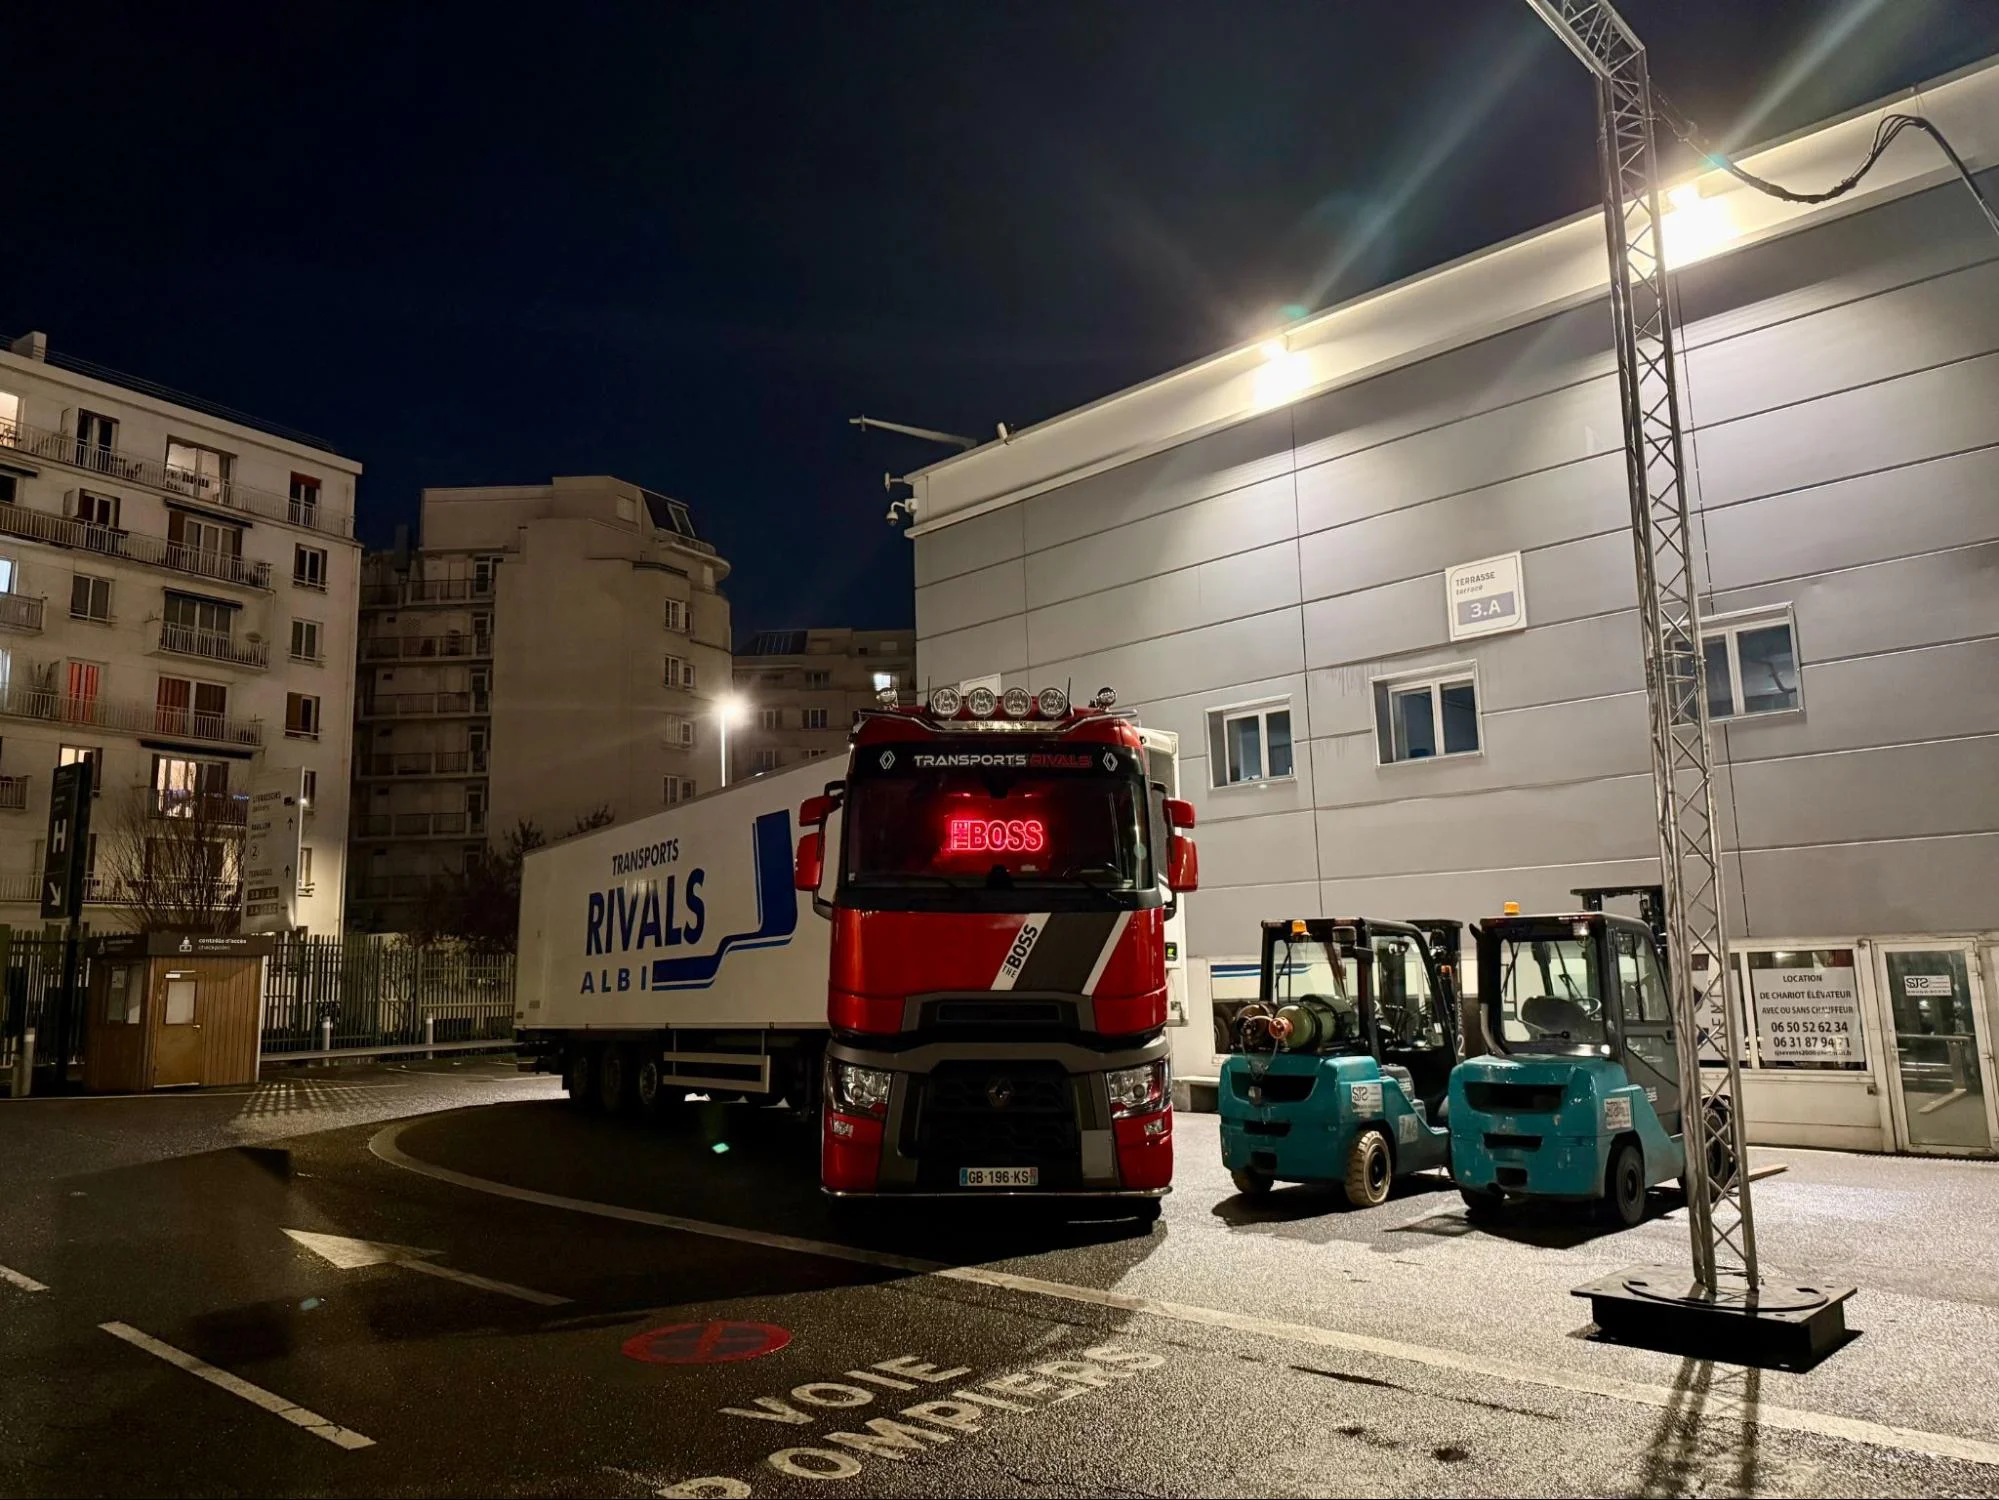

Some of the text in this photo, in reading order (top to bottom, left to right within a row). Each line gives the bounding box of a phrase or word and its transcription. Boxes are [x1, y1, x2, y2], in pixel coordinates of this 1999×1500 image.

[1455, 571, 1496, 586] TERRASSE
[1470, 600, 1501, 618] 3.A
[913, 753, 1093, 767] TRANSPORTS RIVALS
[52, 818, 67, 854] H
[953, 820, 1044, 851] THE BOSS
[612, 838, 680, 876] TRANSPORTS
[585, 868, 705, 956] RIVALS
[1001, 924, 1038, 979] THE BOSS
[580, 966, 648, 995] ALBI
[1782, 974, 1823, 983] LOCATION
[1760, 990, 1852, 1000] DE CHARIOT ÉLÉVATEUR
[1762, 1006, 1779, 1014] AVEC
[1780, 1006, 1791, 1014] OU
[1791, 1006, 1810, 1014] SANS
[1771, 1021, 1848, 1033] 06 50 52 62 34
[1457, 1034, 1465, 1057] 2
[1773, 1036, 1787, 1048] 06
[1789, 1036, 1802, 1048] 31
[1805, 1036, 1818, 1048] 87
[1820, 1036, 1835, 1048] 94
[968, 1170, 1029, 1184] GB-196-KS
[719, 1356, 973, 1424] VOIE
